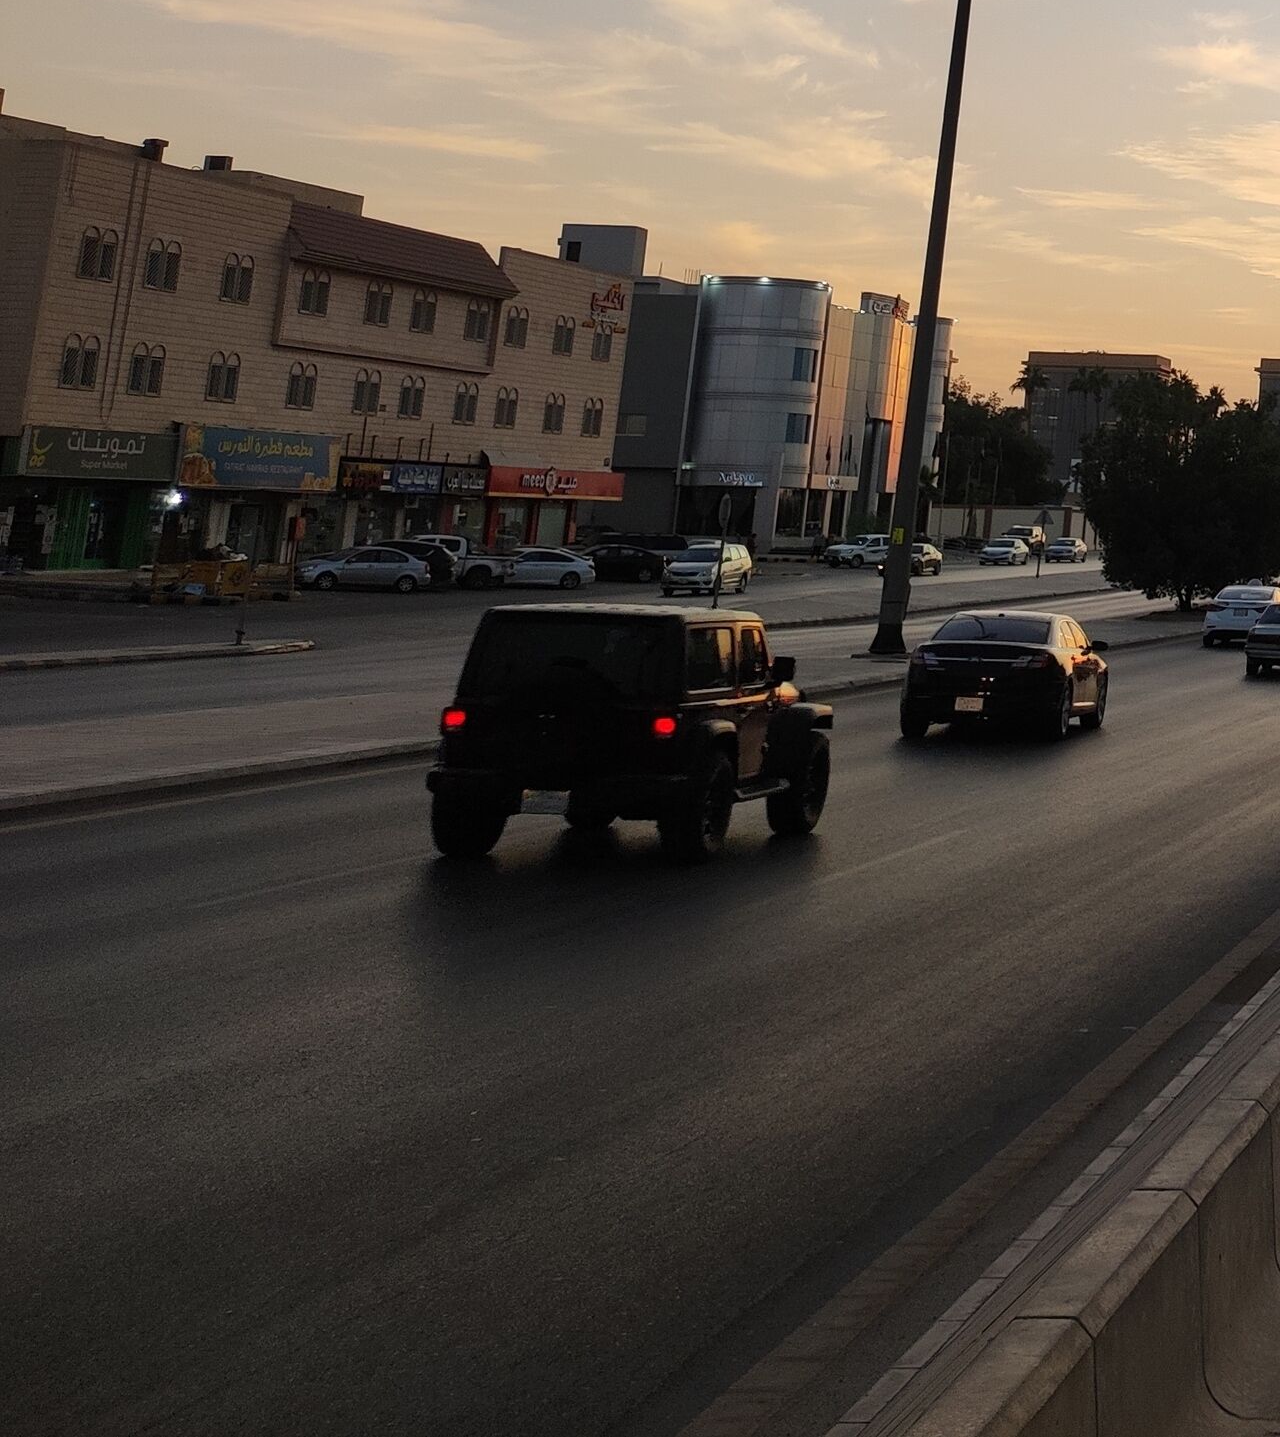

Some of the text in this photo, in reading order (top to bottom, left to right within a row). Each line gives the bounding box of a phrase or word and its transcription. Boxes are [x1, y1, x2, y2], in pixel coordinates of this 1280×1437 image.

[67, 430, 147, 459] تموينات
[284, 438, 314, 458] مطعم
[80, 459, 128, 470] Super Market
